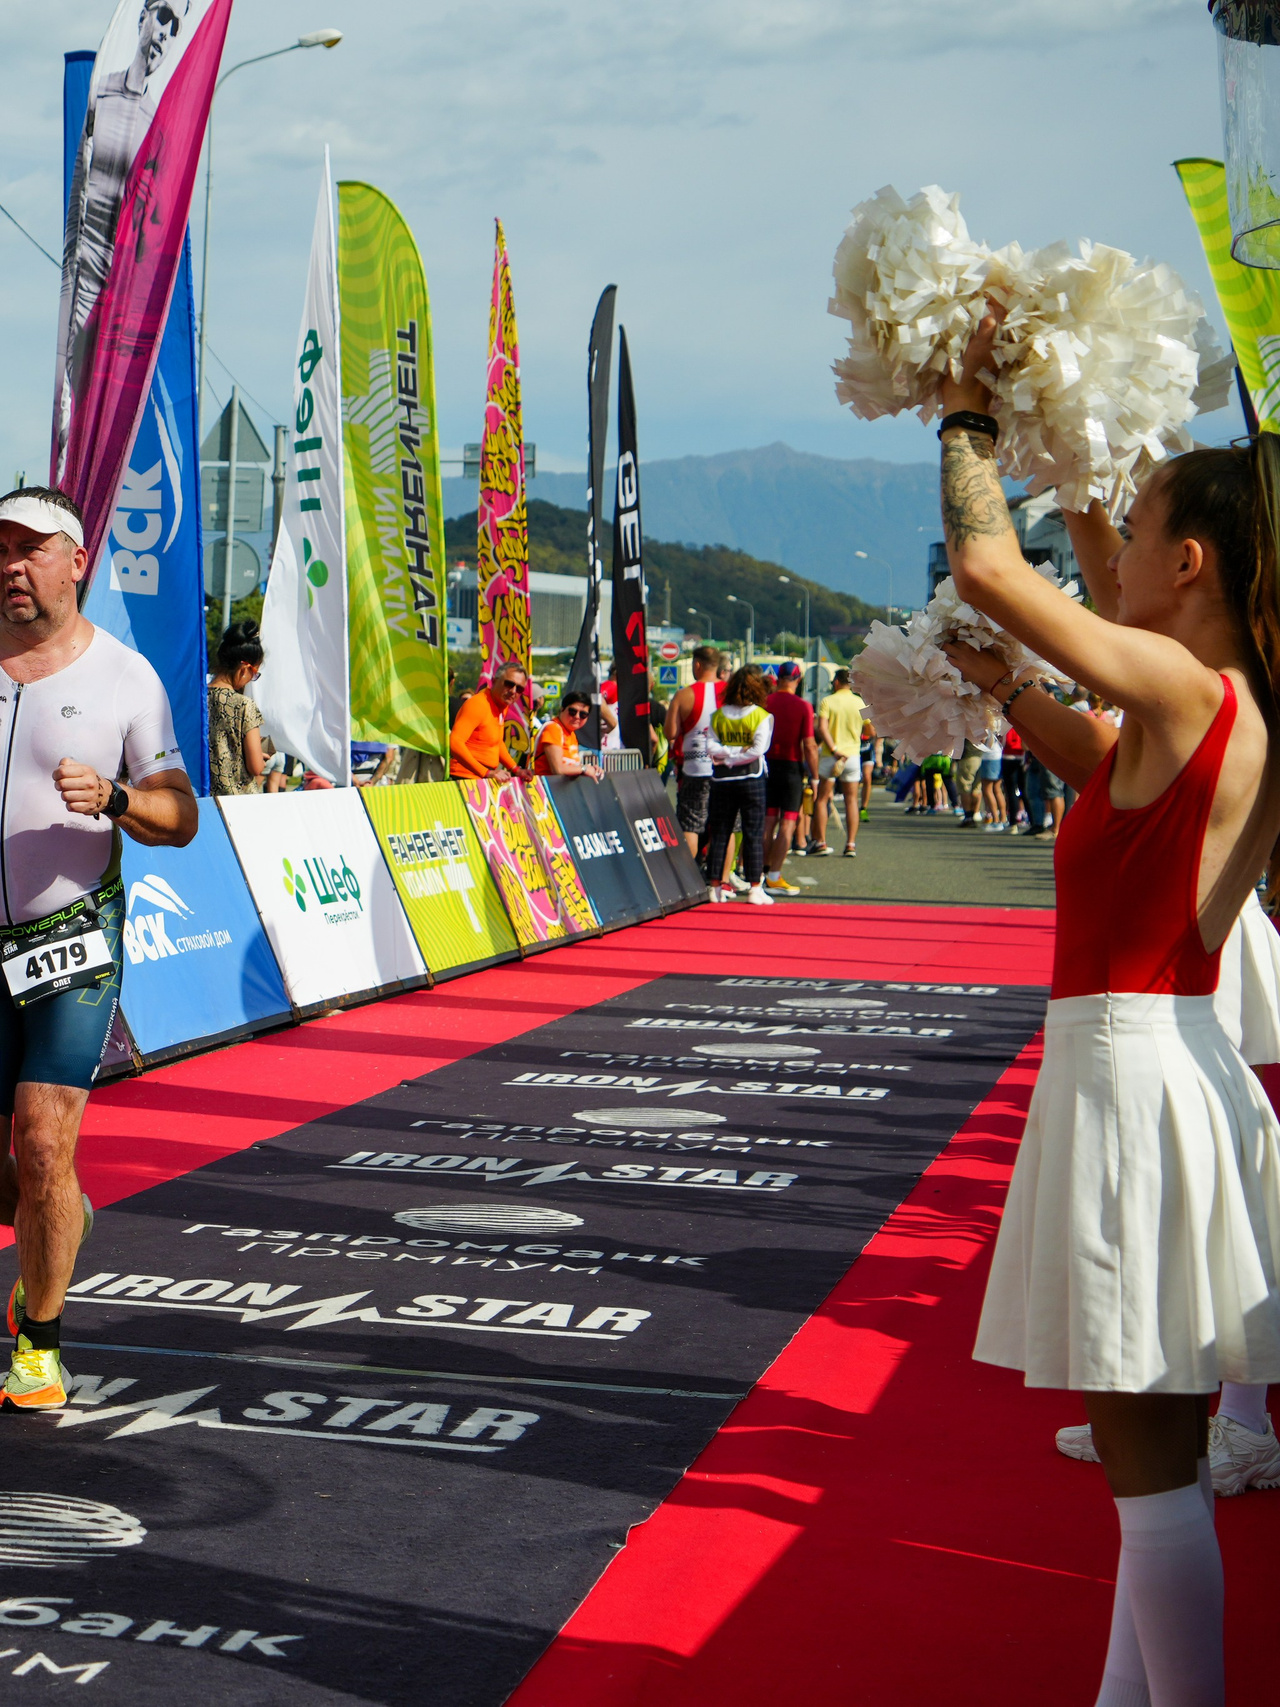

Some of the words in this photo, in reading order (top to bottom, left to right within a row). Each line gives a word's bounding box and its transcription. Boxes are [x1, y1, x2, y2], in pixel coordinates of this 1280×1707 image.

[109, 459, 163, 596] ВСК
[387, 827, 469, 867] FAHRENHEIT
[634, 816, 679, 853] GEL4U
[303, 854, 363, 912] Шеф
[0, 901, 87, 938] POWERUP
[122, 911, 179, 965] ВСК
[176, 929, 214, 954] СТРАХОВОЙ
[213, 929, 233, 948] ДОМ
[25, 942, 88, 980] 4179
[53, 976, 72, 988] ОЛЕГ
[631, 1017, 758, 1030] IRON
[818, 1024, 955, 1038] STAR
[516, 1072, 662, 1088] IRON
[731, 1080, 893, 1099] STAR
[409, 1119, 834, 1148] Газпромбанк
[460, 1131, 755, 1154] Премиум
[345, 1151, 522, 1173] IRON
[601, 1164, 800, 1189] STAR
[181, 1224, 710, 1267] Газпромбанк
[237, 1241, 604, 1276] Премиум
[66, 1272, 299, 1306] IRON
[395, 1293, 654, 1333] STAR
[242, 1390, 543, 1443] STAR
